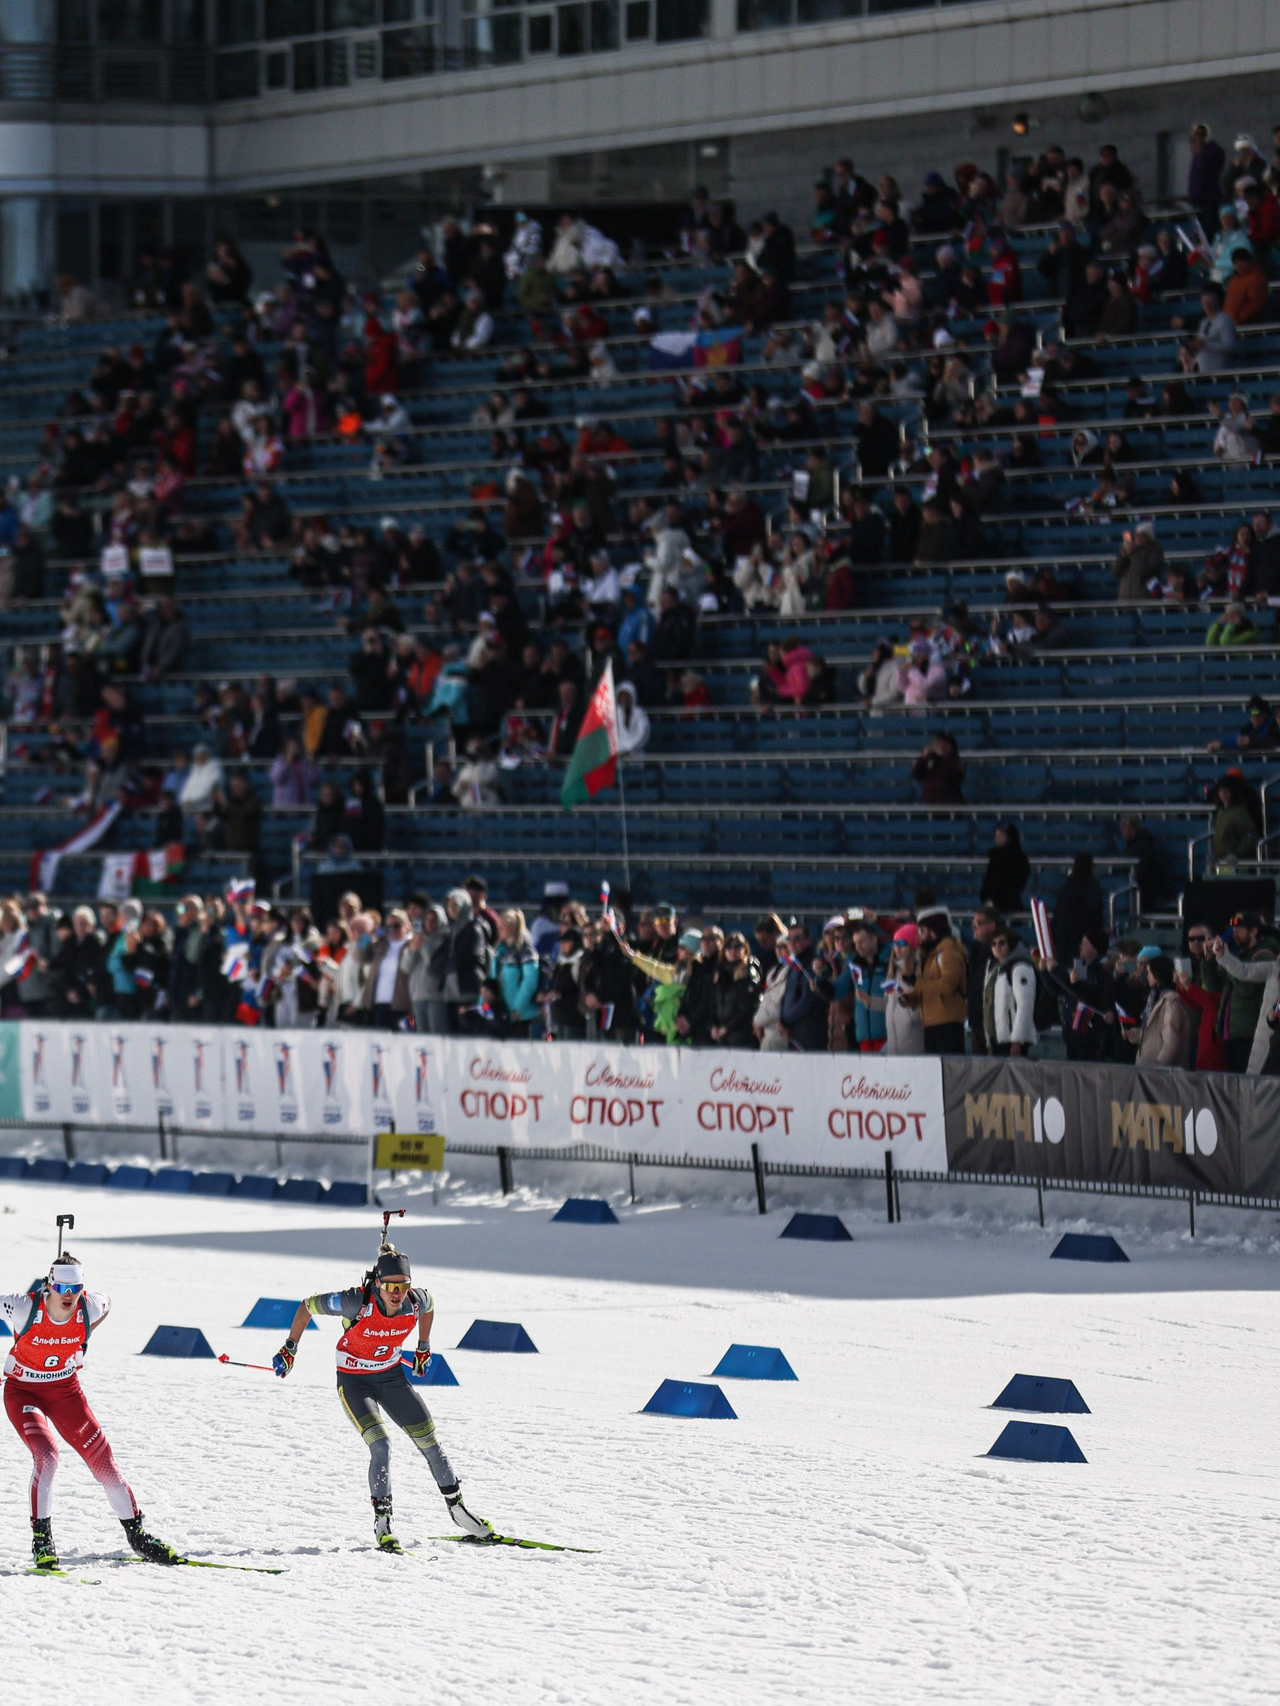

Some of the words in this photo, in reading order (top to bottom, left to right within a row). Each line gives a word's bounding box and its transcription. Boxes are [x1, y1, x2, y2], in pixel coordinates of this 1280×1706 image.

[460, 1088, 545, 1122] СПОРТ
[570, 1095, 665, 1128] СПОРТ
[696, 1100, 794, 1136] СПОРТ
[827, 1107, 927, 1142] СПОРТ
[363, 1328, 389, 1338] Альфа
[32, 1336, 60, 1345] Альфа
[61, 1336, 80, 1344] Банк
[373, 1345, 390, 1358] 2
[44, 1354, 60, 1368] 6
[25, 1365, 76, 1379] ТЕХНОНИКОЛ
